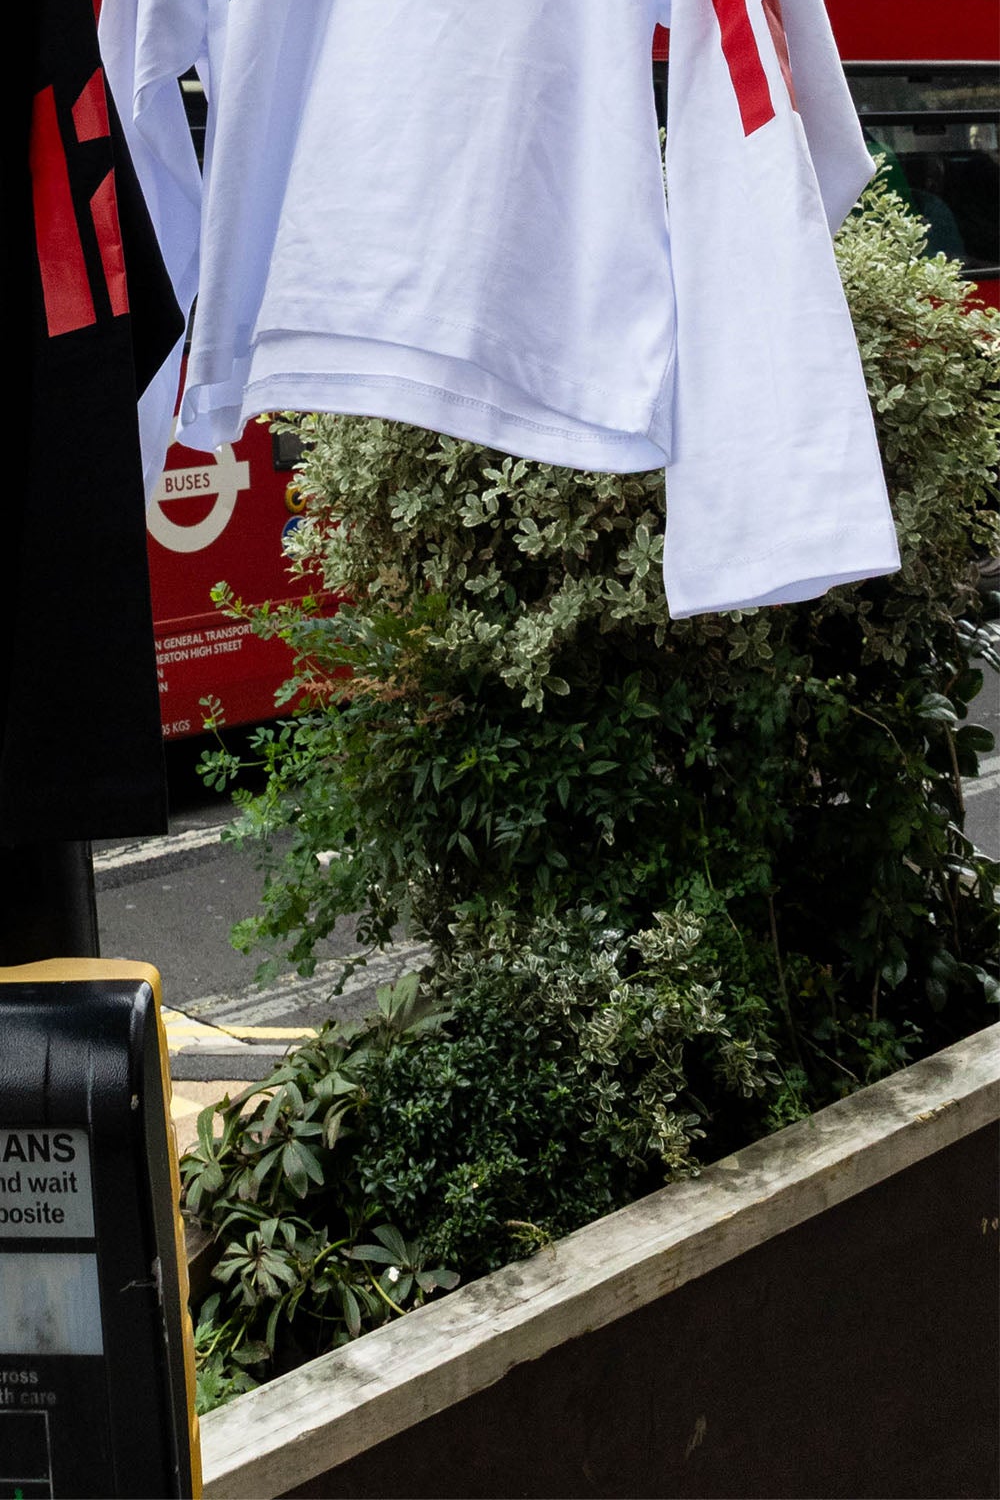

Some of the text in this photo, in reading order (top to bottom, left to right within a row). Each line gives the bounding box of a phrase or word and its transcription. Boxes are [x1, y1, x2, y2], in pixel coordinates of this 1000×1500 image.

[164, 472, 211, 493] BUSES
[164, 633, 203, 648] GENERAL
[190, 645, 213, 658] HIGH
[214, 639, 242, 653] STREET
[172, 720, 191, 733] KGS
[28, 1171, 78, 1193] wait
[19, 1393, 57, 1405] care
